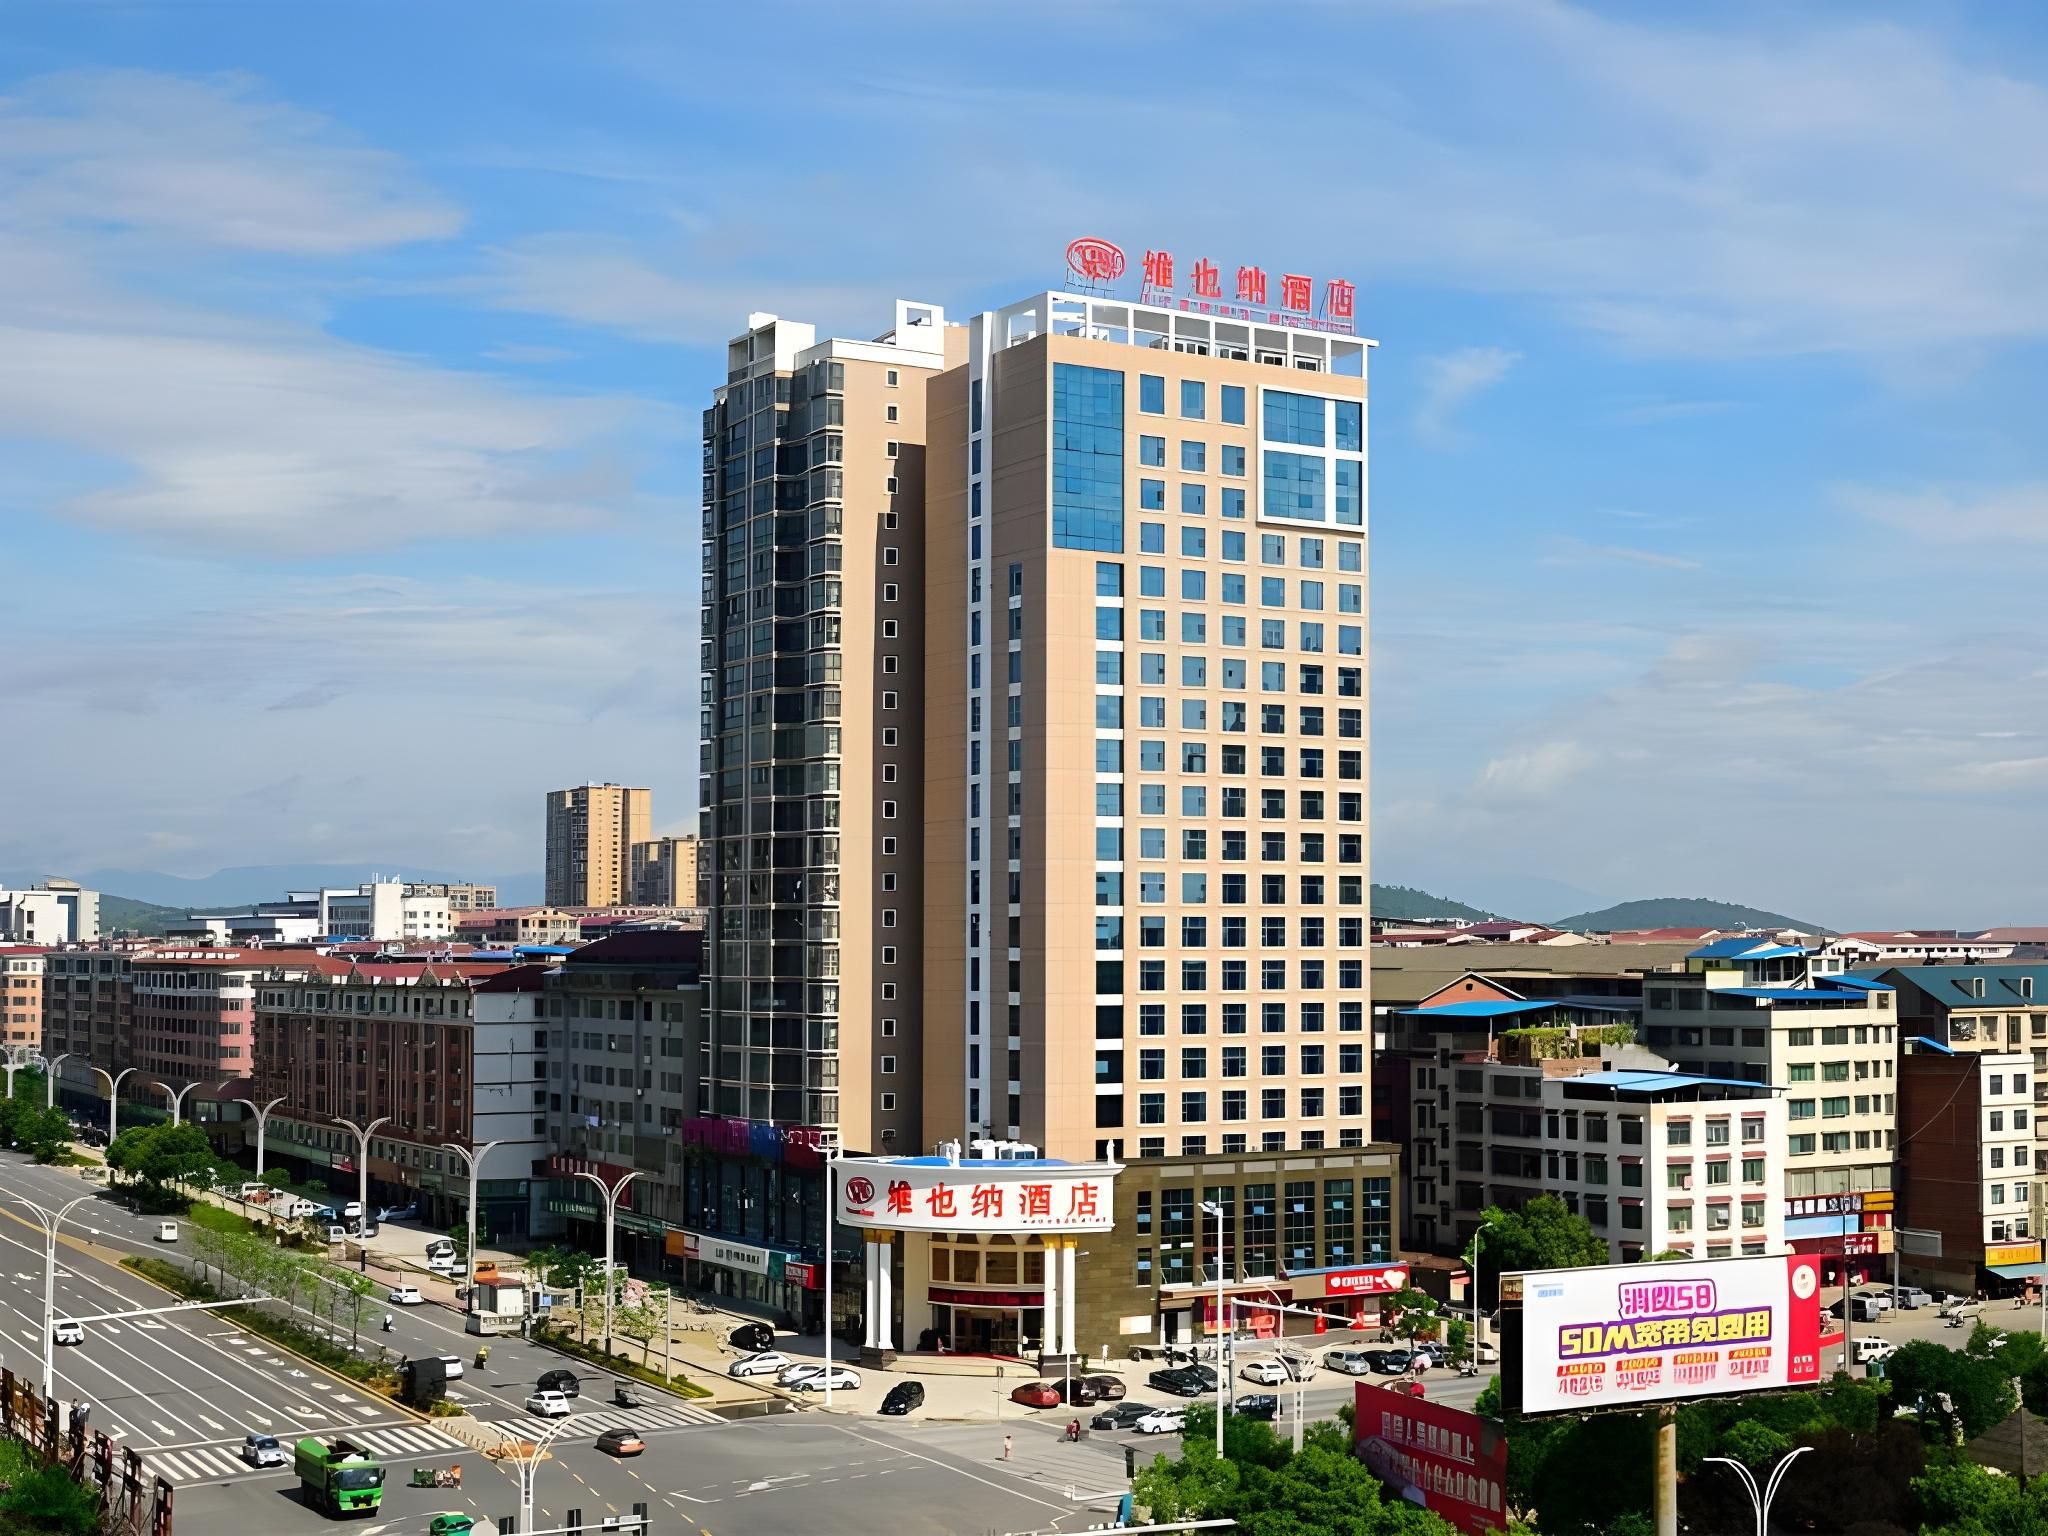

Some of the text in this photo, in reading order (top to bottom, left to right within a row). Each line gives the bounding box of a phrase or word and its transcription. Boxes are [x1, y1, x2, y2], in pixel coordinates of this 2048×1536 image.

[887, 1179, 1098, 1218] 维也纳酒店
